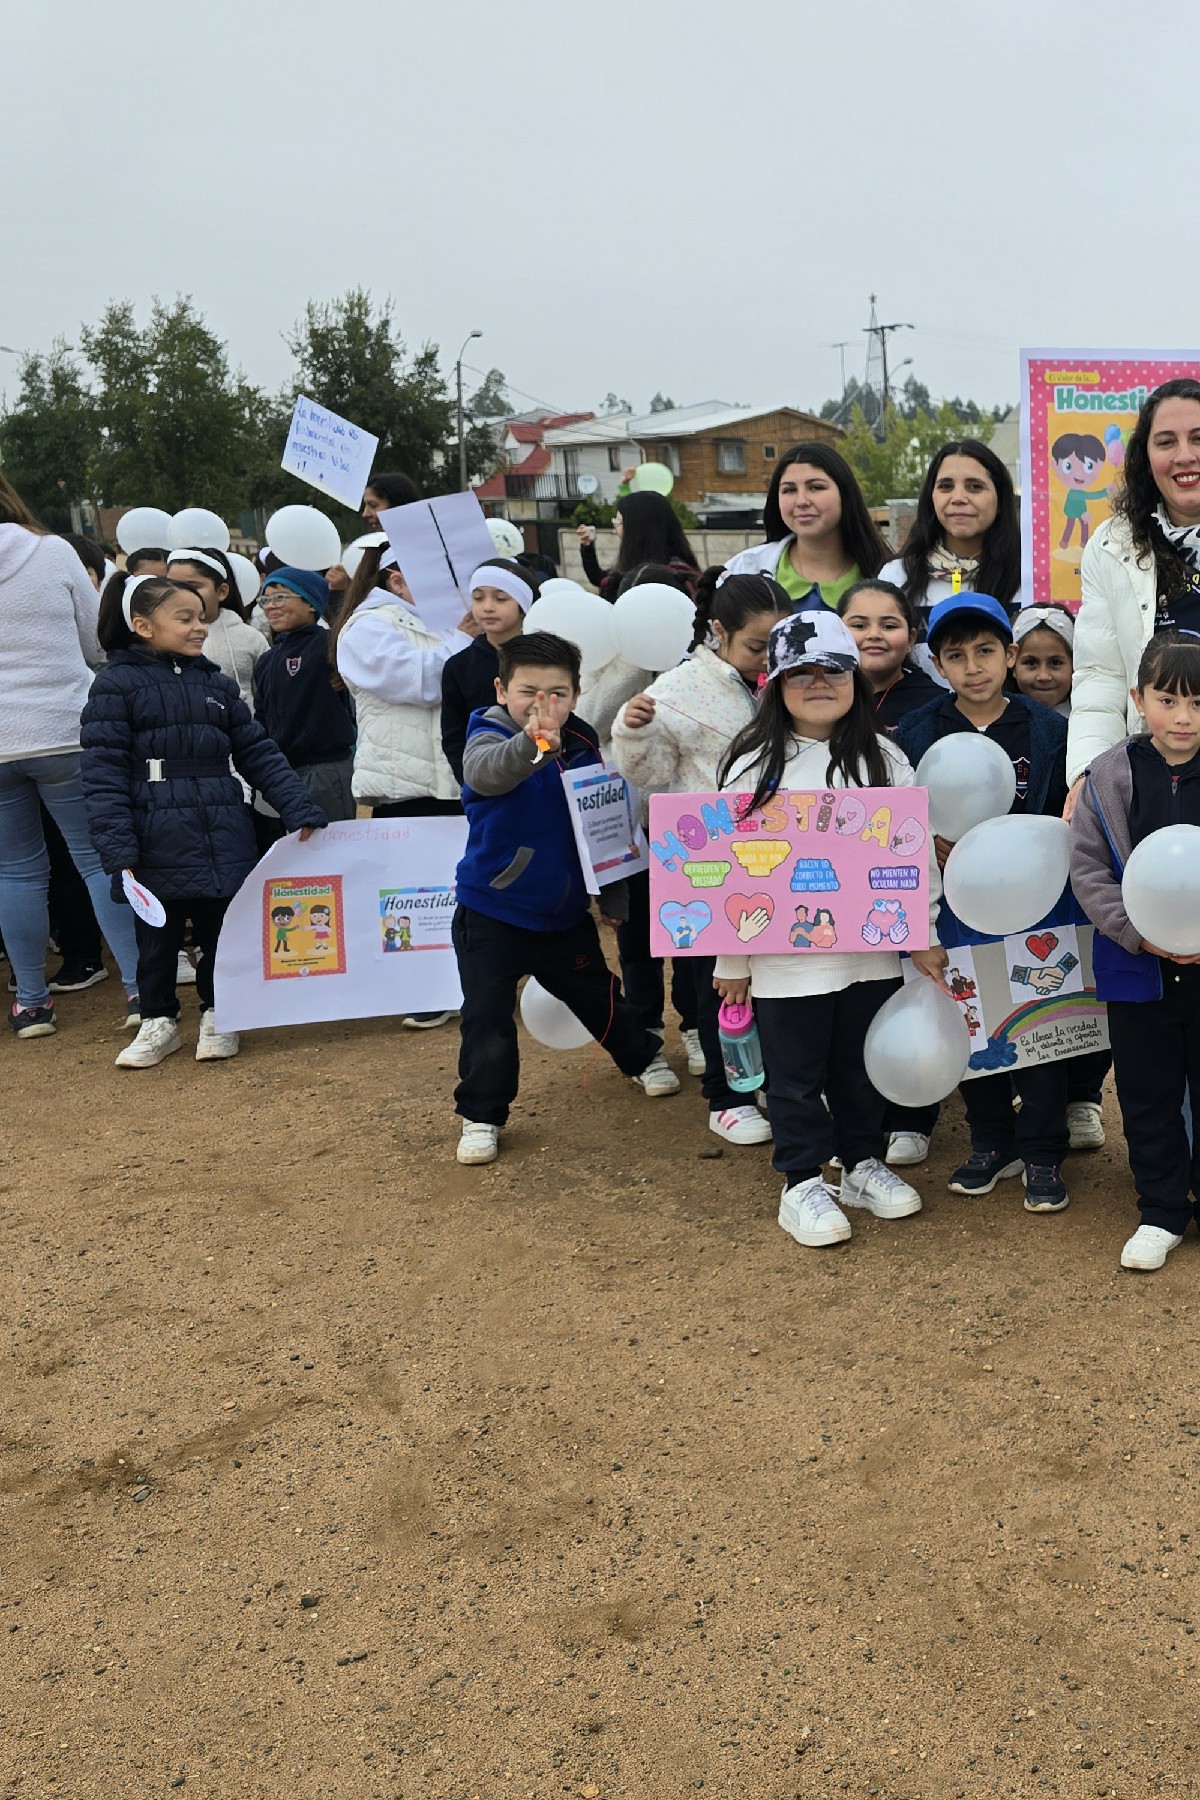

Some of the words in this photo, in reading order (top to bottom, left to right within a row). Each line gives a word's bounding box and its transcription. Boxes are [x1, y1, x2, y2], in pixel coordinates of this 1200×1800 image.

[1056, 387, 1146, 411] Honesti
[870, 869, 880, 878] NO
[882, 868, 908, 878] MIENTEN
[272, 886, 332, 898] Honestidad
